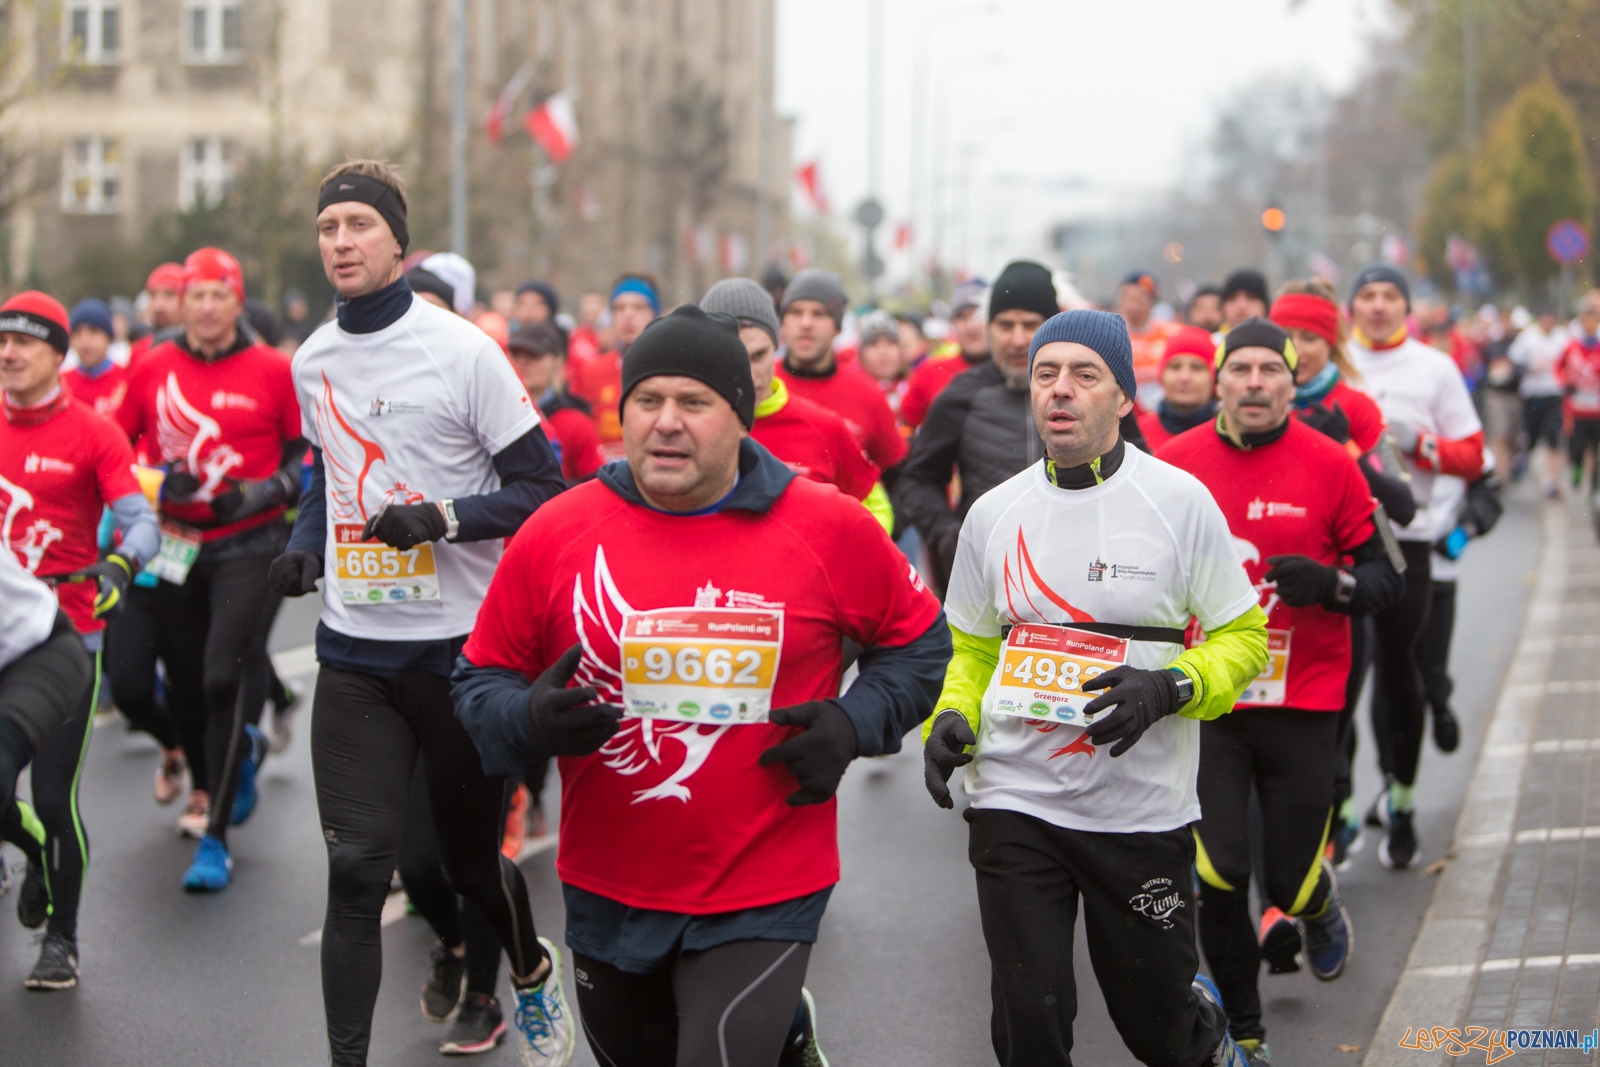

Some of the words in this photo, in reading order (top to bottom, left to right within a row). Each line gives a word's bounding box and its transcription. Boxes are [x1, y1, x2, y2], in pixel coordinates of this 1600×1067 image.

[346, 548, 420, 577] 6657
[1110, 563, 1118, 578] 1
[725, 589, 735, 608] 1
[708, 622, 772, 636] RunPoland.org
[1065, 639, 1118, 657] RunPoland.org
[626, 657, 639, 669] D
[643, 646, 763, 685] 9662
[1004, 663, 1012, 673] D
[1033, 691, 1069, 703] Grzegorz
